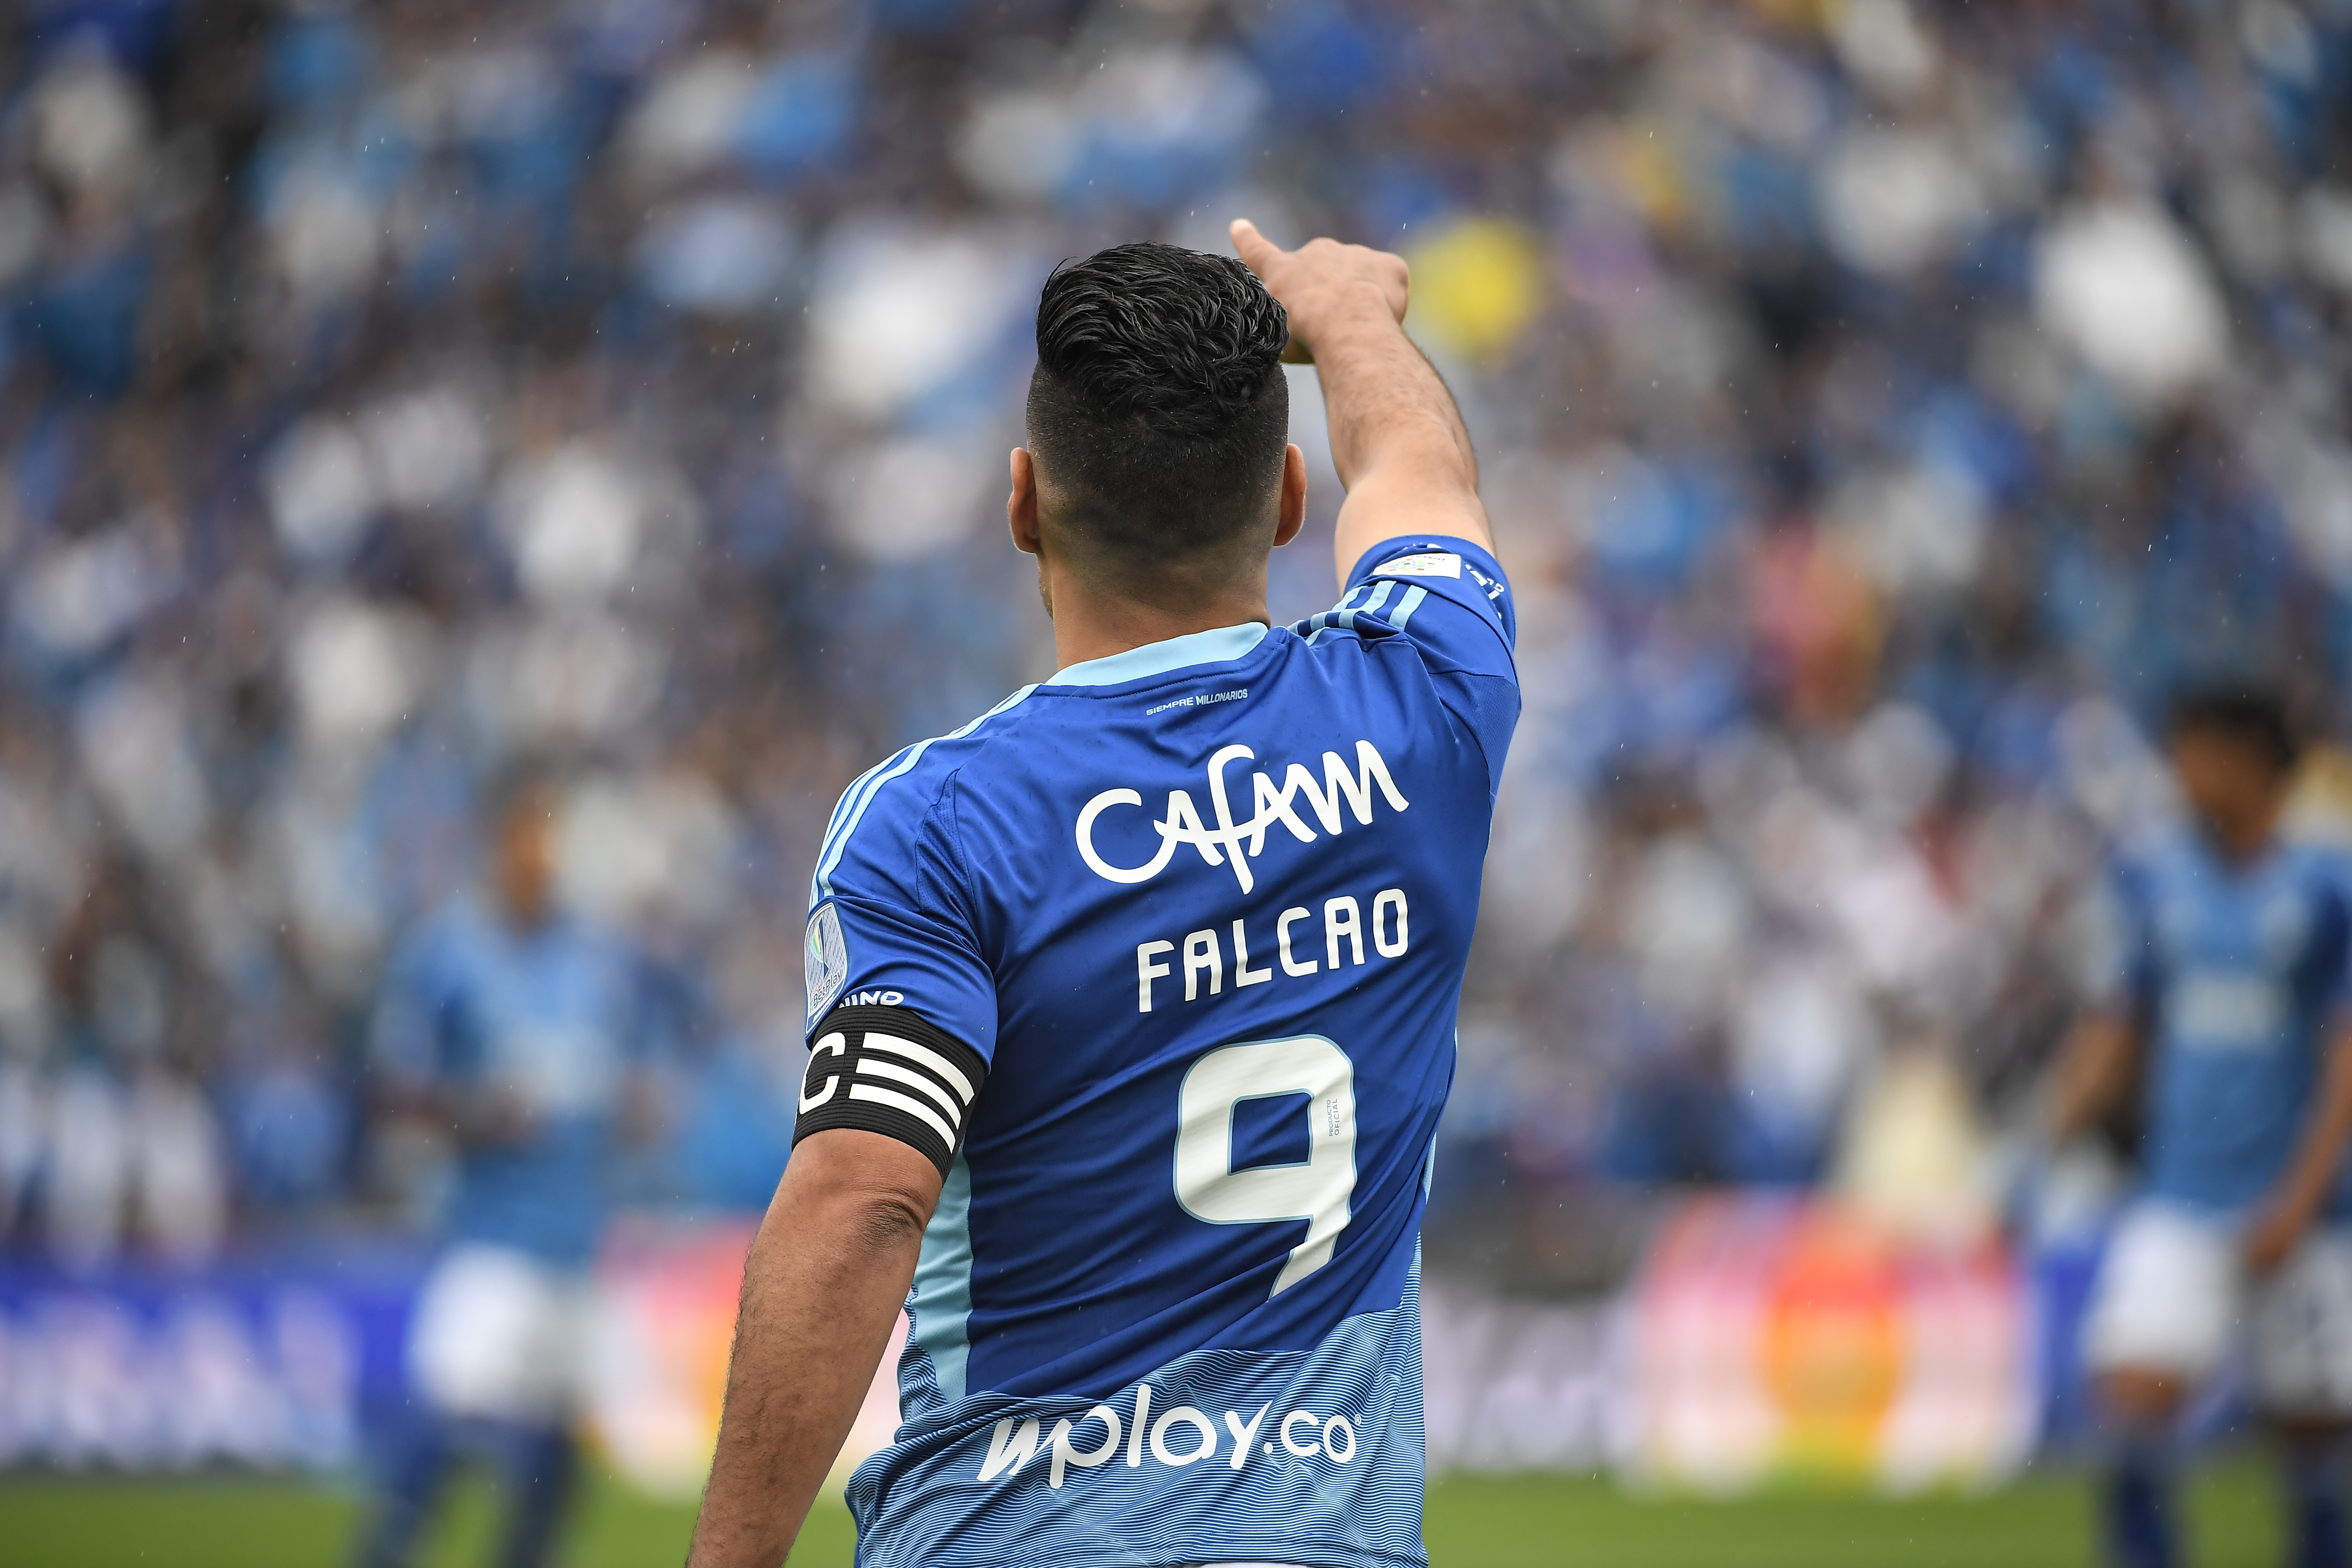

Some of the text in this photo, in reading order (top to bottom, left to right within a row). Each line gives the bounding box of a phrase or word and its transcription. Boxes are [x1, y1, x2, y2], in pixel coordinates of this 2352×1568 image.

[1146, 689, 1248, 715] SIEMPRE MILLONARIOS
[813, 968, 843, 1007] BetPlay
[1137, 889, 1408, 1013] FALCAO
[1173, 1034, 1357, 1303] 9
